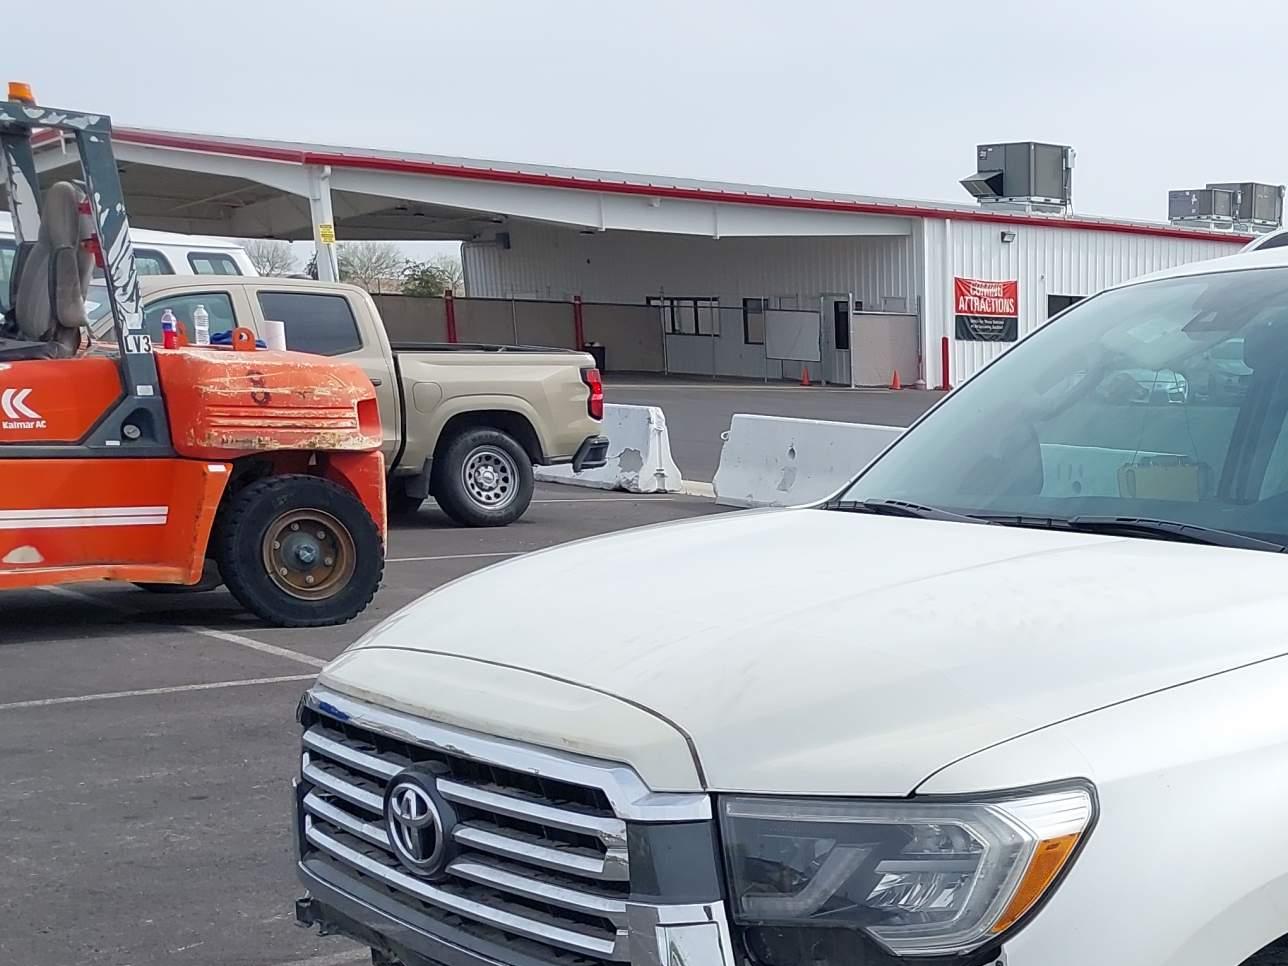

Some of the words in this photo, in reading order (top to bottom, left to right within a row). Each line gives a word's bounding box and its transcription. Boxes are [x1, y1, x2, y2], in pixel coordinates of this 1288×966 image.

[958, 296, 1015, 313] ATTRACTIONS
[123, 335, 152, 353] LV3
[2, 421, 34, 429] Kalmar
[35, 420, 47, 428] AC
